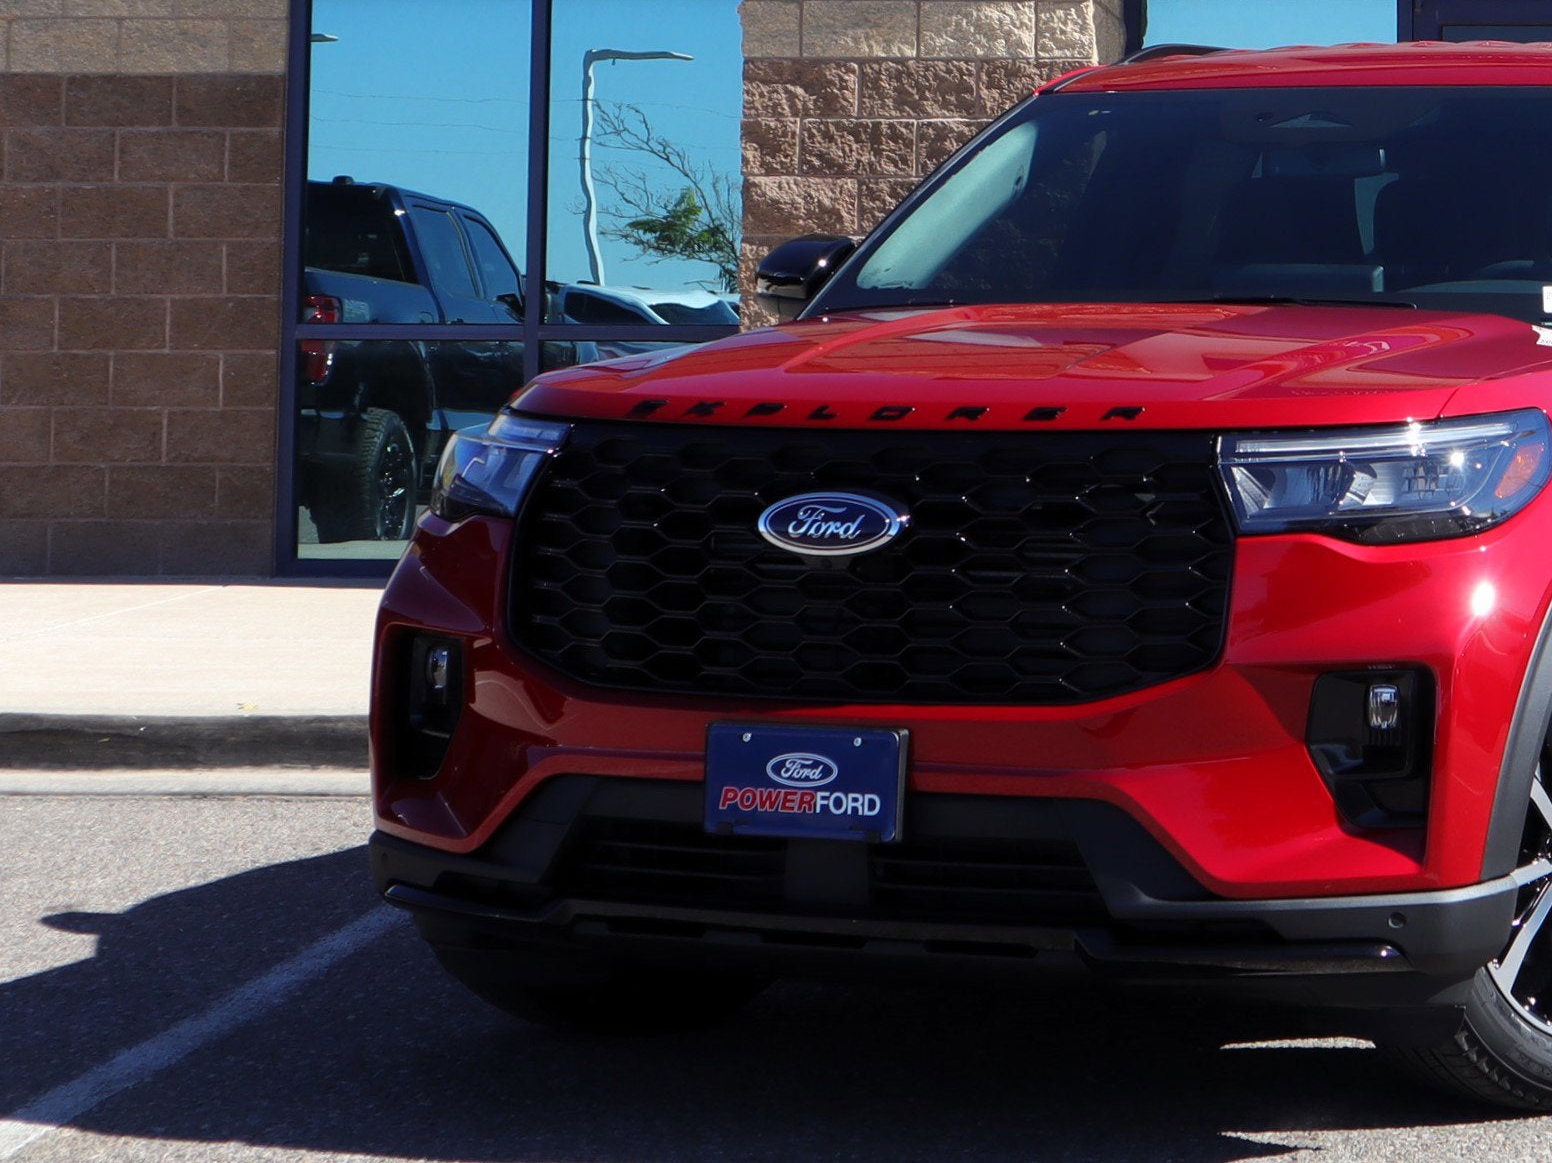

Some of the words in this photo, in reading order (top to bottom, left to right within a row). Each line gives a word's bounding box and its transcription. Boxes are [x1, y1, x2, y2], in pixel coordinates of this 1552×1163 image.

[626, 400, 1146, 421] EXPLORER
[788, 504, 866, 539] Ford
[780, 758, 824, 781] Ford
[719, 787, 881, 816] POWERFORD
